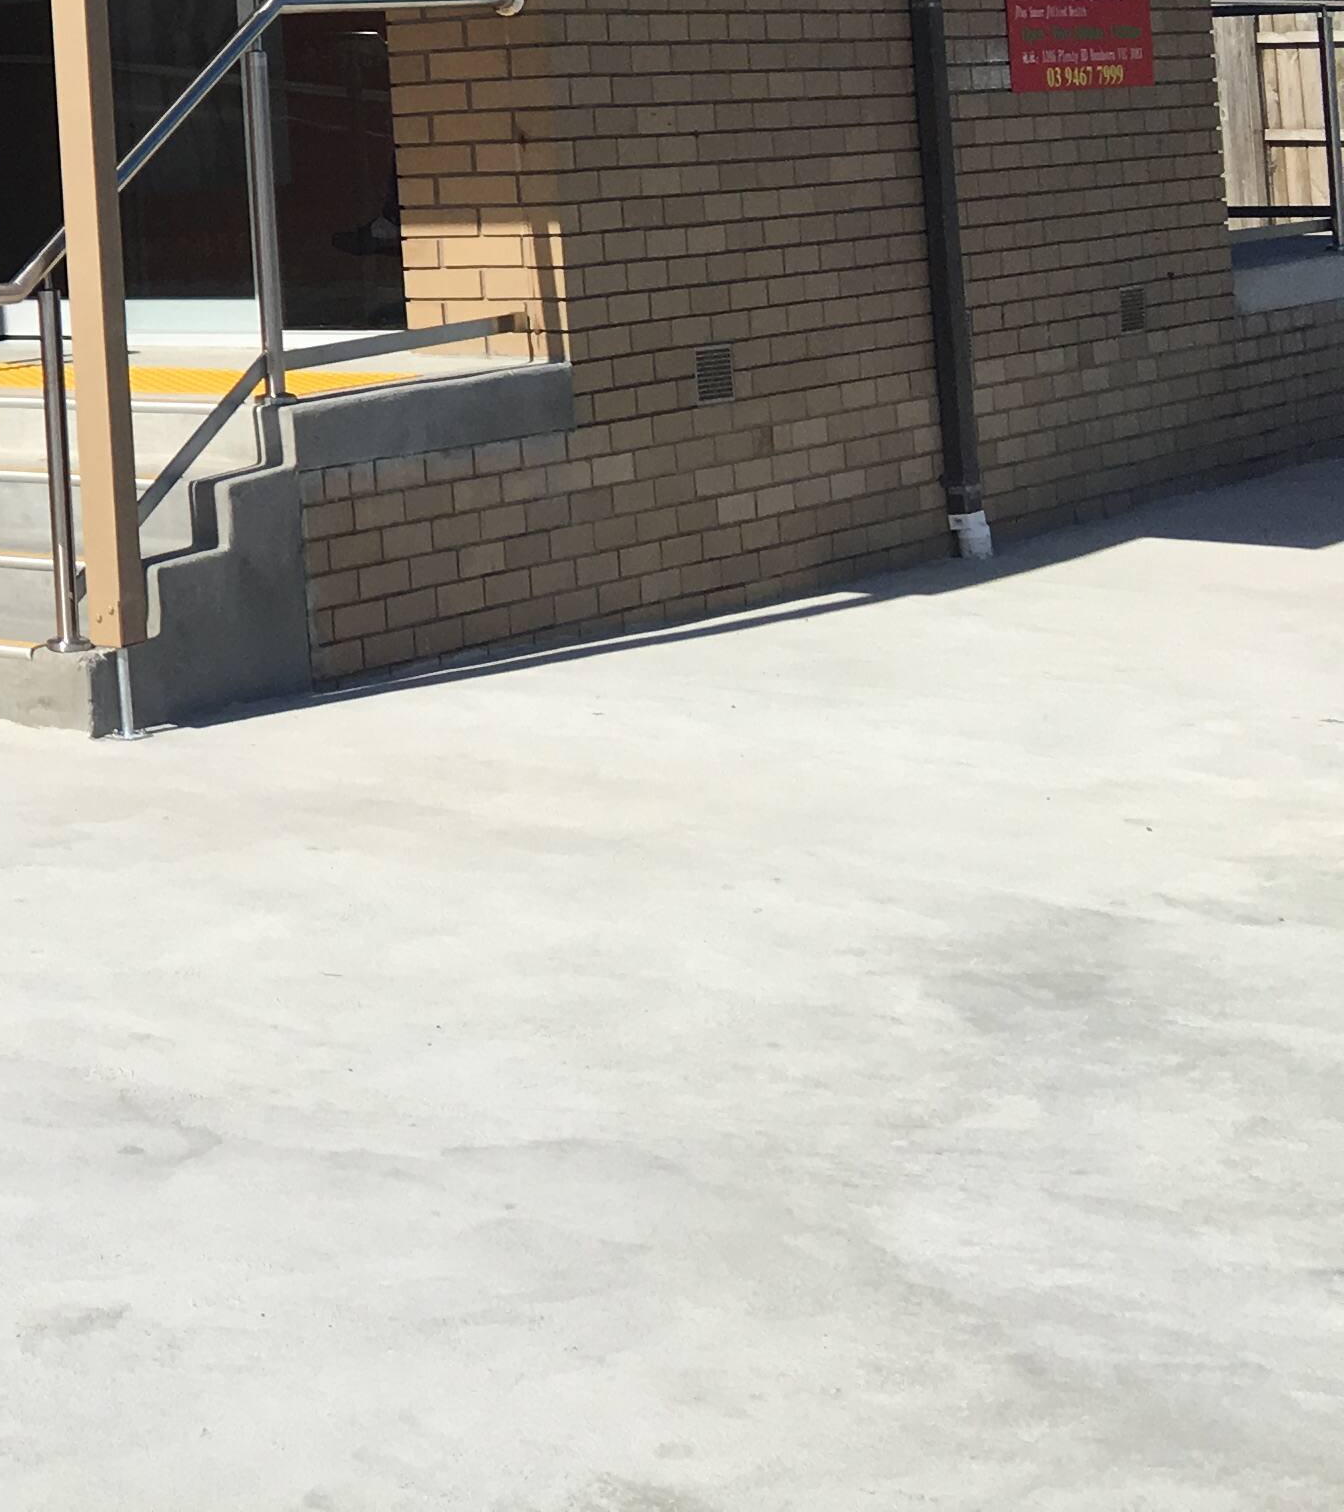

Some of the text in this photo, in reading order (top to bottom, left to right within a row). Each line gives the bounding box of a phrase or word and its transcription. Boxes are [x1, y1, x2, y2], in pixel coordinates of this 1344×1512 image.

[1047, 64, 1124, 87] 03 9467 7999
